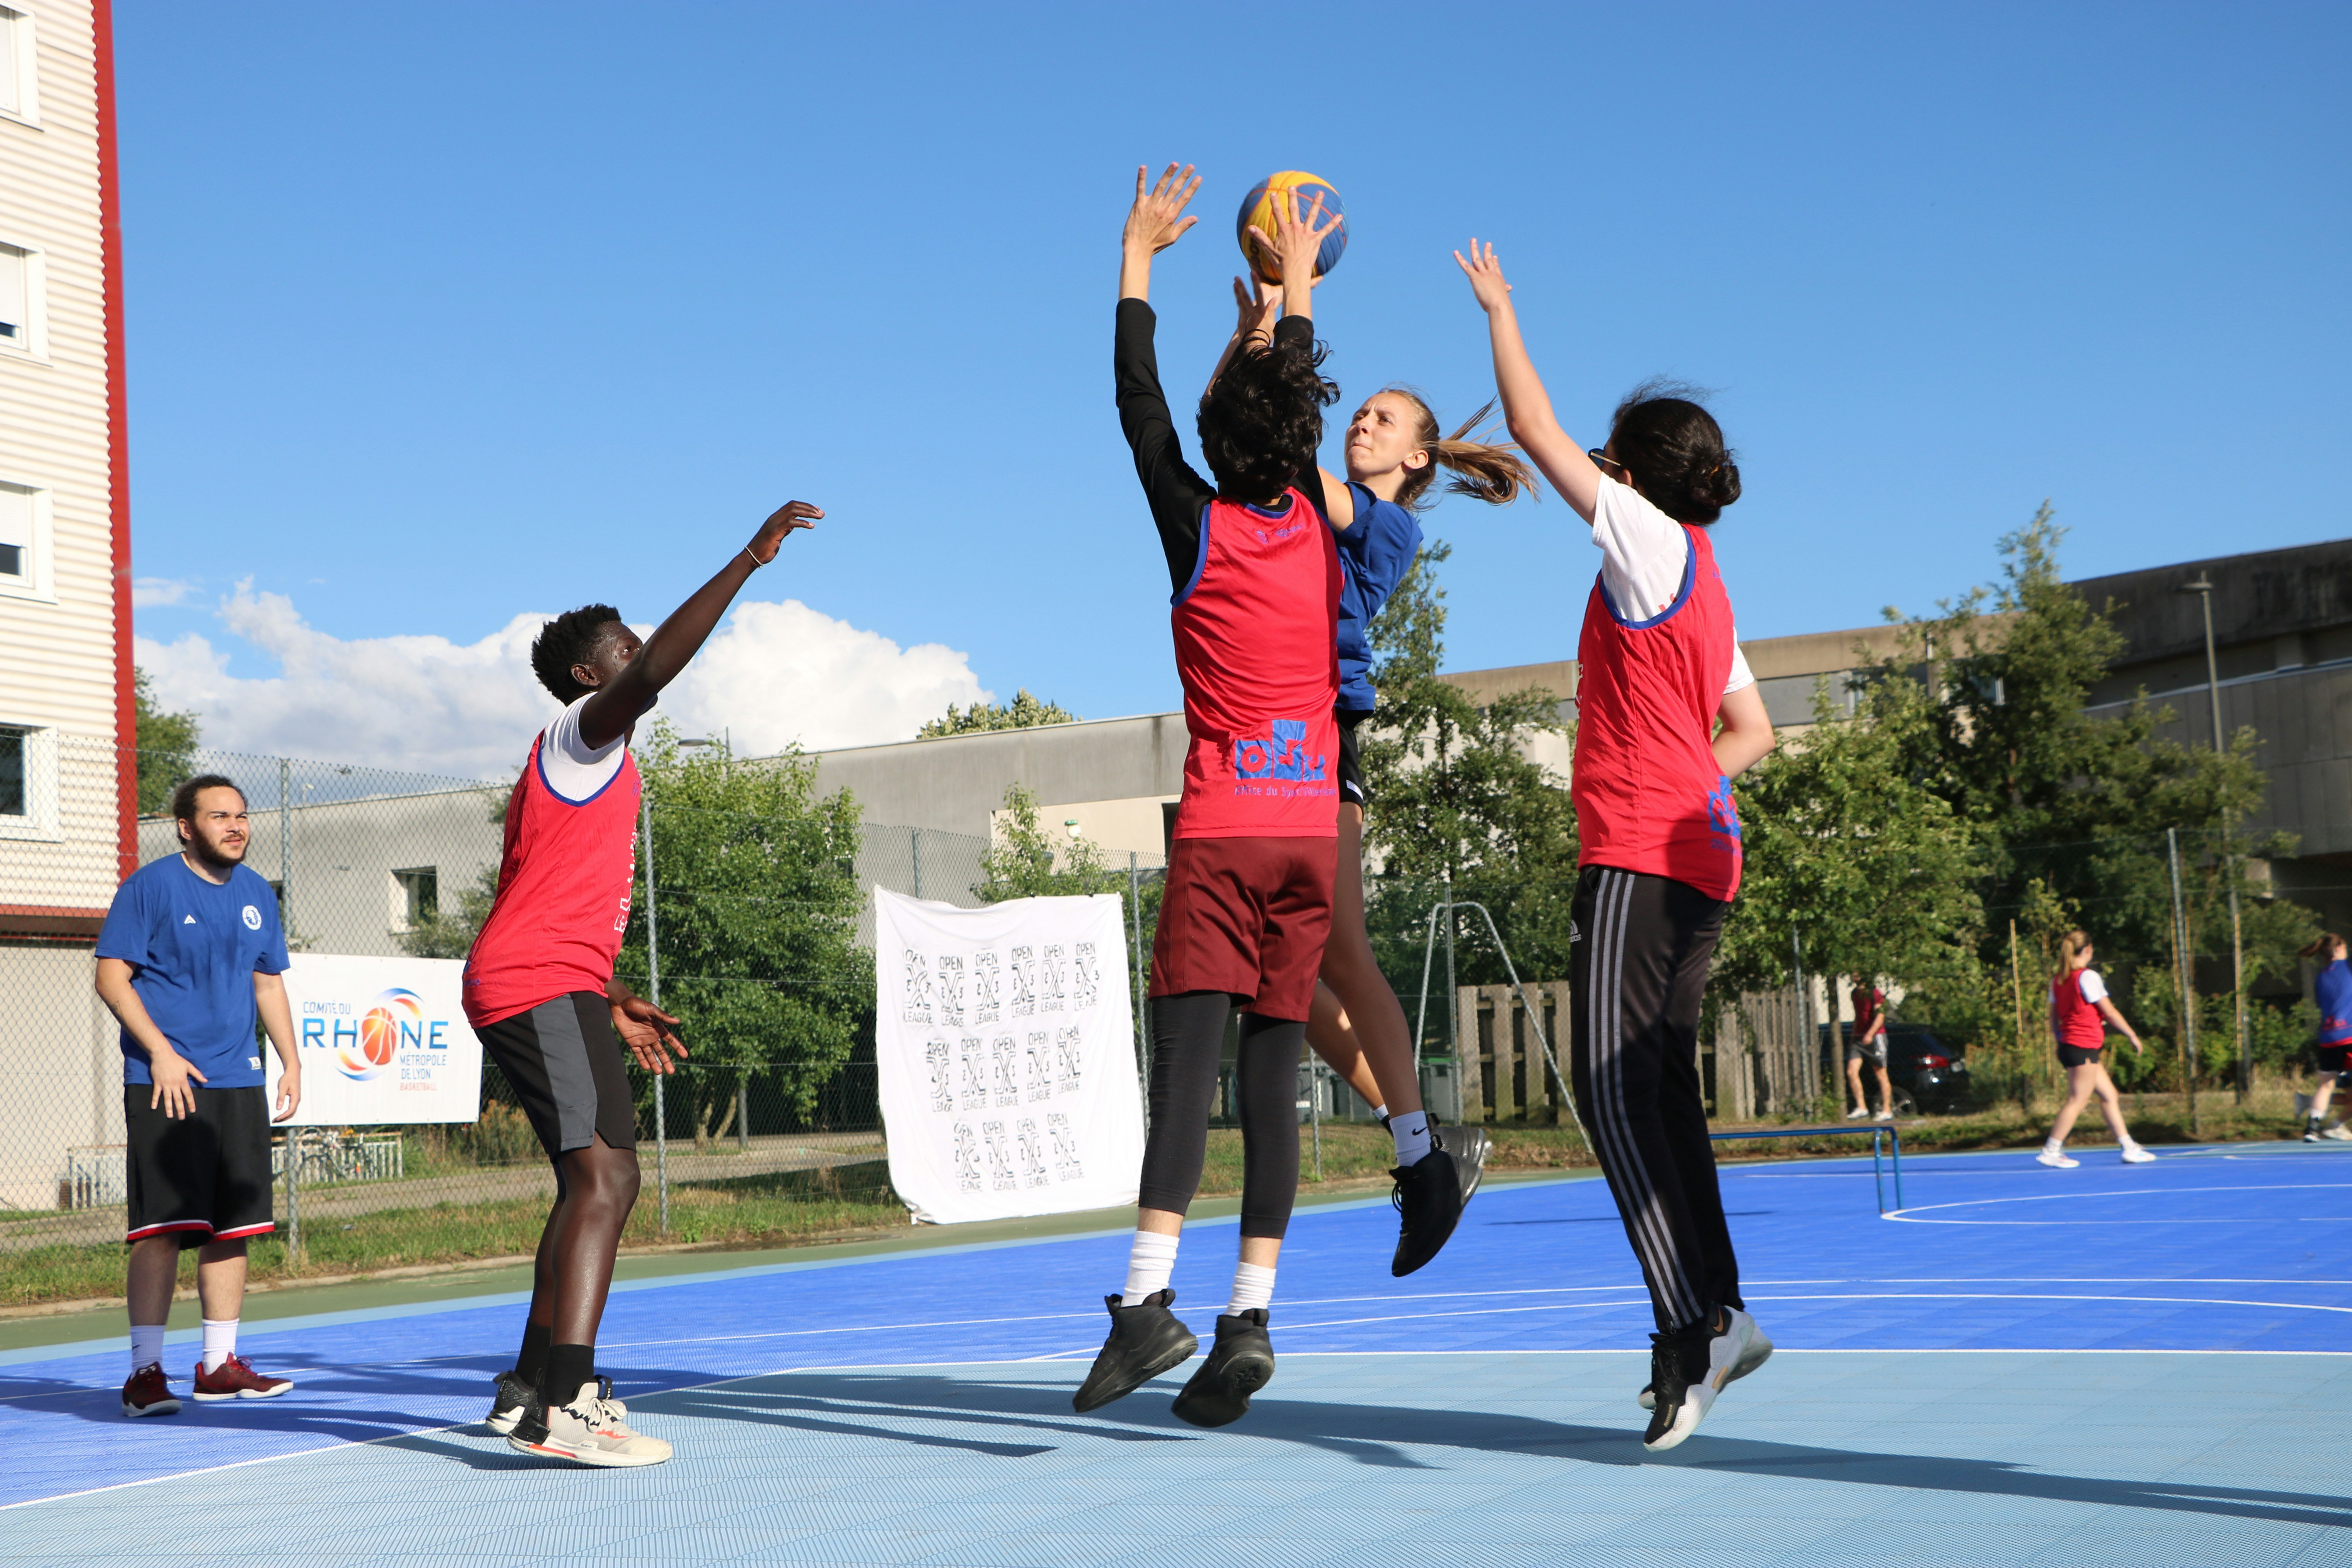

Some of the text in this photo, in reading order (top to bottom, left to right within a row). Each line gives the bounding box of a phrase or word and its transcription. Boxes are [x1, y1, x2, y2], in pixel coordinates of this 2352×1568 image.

[1235, 784, 1262, 795] Office
[1266, 786, 1278, 796] du
[1281, 786, 1302, 799] Spor
[1012, 945, 1033, 962] OPEN
[1044, 943, 1064, 958] OPEN
[1076, 942, 1096, 956] OPEN
[906, 949, 926, 967] ON
[939, 956, 963, 970] OPEN
[976, 952, 998, 967] OPEN
[303, 1000, 351, 1014] COMITÉ DU
[1011, 1004, 1035, 1018] LEAGUE
[1041, 1001, 1064, 1012] LEAGUE
[903, 1011, 933, 1024] LEAGUE
[975, 1011, 1000, 1025] LEAGUE
[1028, 1031, 1049, 1045] OPEN
[1059, 1023, 1079, 1040] OPN
[927, 1042, 949, 1057] OPEN
[961, 1038, 982, 1052] OPEN
[993, 1036, 1016, 1051] OPEN
[400, 1051, 447, 1066] MÉTROPOLE
[401, 1068, 431, 1080] DE LYON
[400, 1082, 437, 1091] BASKETBALL
[1058, 1080, 1080, 1094] LEAGUE
[996, 1095, 1019, 1107] LEAGUE
[1028, 1089, 1051, 1103] LEAGUE
[963, 1097, 987, 1111] LEAGUE
[1016, 1118, 1036, 1133] OPEN
[1047, 1113, 1068, 1126] OPEN
[954, 1122, 973, 1138] OEN
[982, 1120, 1005, 1135] OPEN
[1058, 1168, 1085, 1182] LEAGUE
[1025, 1176, 1050, 1189] LEAGUE
